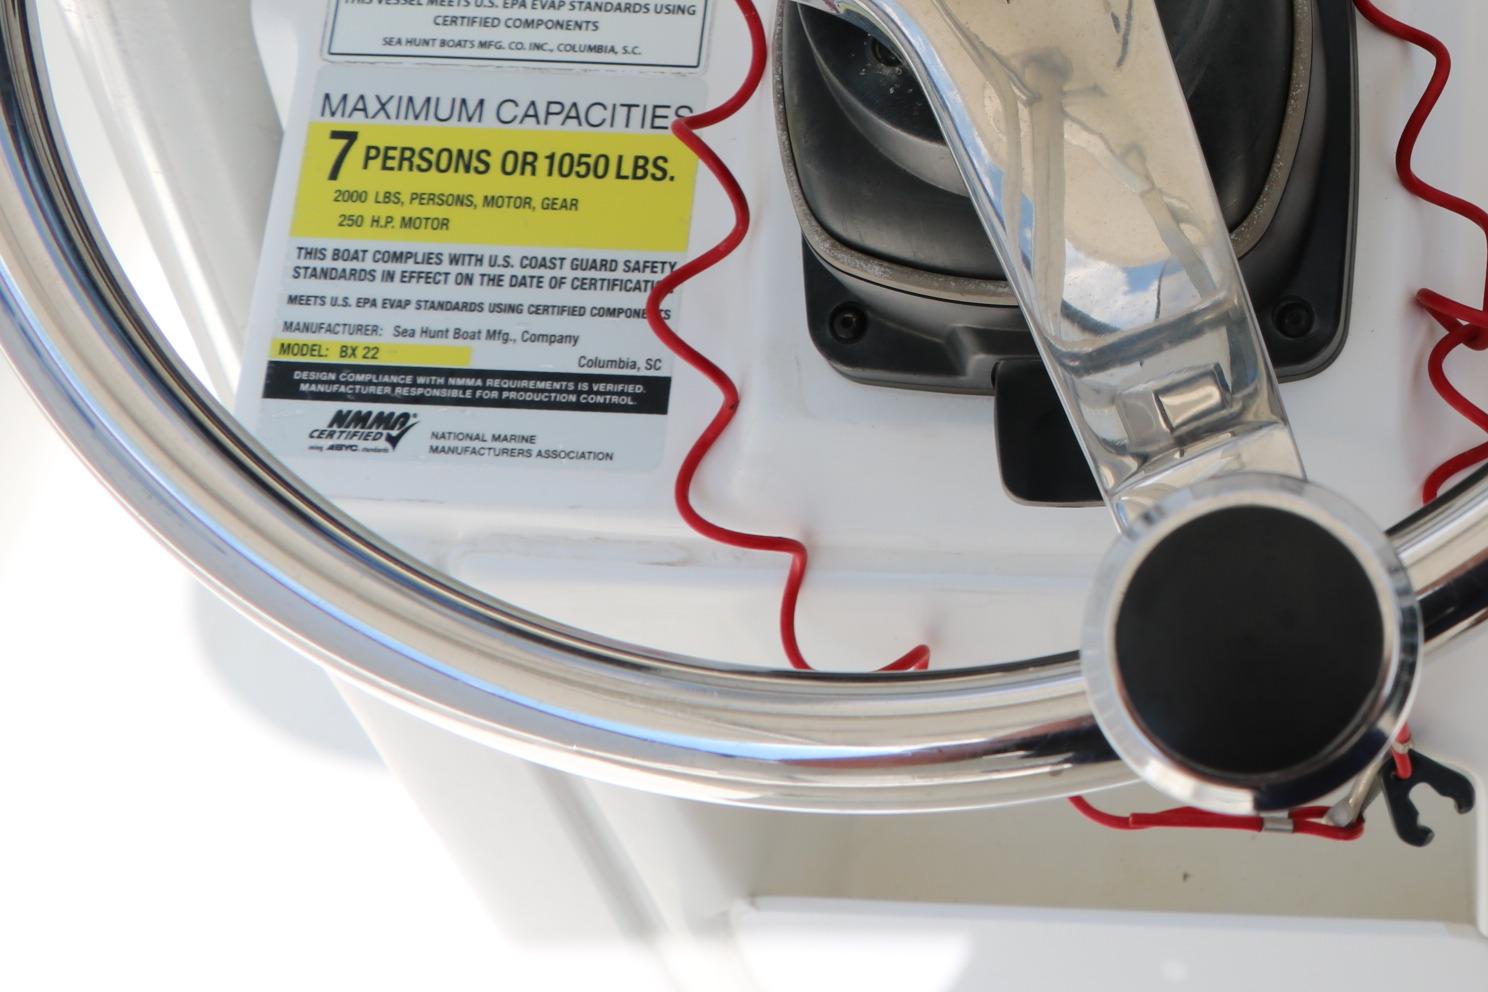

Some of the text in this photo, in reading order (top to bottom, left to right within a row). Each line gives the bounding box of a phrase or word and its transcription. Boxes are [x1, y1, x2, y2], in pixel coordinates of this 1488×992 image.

[530, 0, 566, 10] EVAP
[568, 0, 651, 13] STANDARDS
[653, 4, 696, 15] USING
[432, 15, 599, 31] CERTIFIED COMPONENTS
[381, 37, 403, 46] SEA
[404, 37, 437, 47] HUNT
[438, 39, 476, 48] BOATS
[320, 93, 485, 122] MAXIMUM
[327, 130, 676, 181] 7 PERSONS OR 1050 LBS.
[333, 189, 579, 211] 2000 LBS, PERSONS, MOTOR, GEAR
[337, 214, 449, 230] 250 H.P. MOTOR
[295, 246, 677, 274] THIS BOAT COMPLIES WITH U.S. COAST GUARD SAFETY
[292, 266, 674, 294] STANDARDS IN EFFECT ON THE DATE OF CERTIFICATI
[287, 294, 672, 320] MEETS U.S. EPA EVAP STANDARDS USING CERTIFIED COMPONES
[282, 321, 579, 346] MANUFACTURER: Sea Hunt Boat Mfg., Company
[278, 342, 379, 359] MODEL: BX 22
[577, 356, 662, 370] Columbia, SC
[308, 429, 384, 441] CERTIFIED
[430, 431, 536, 444] NATIONAL MARINE
[428, 445, 613, 460] MANUFACTURERS ASSOCIATION
